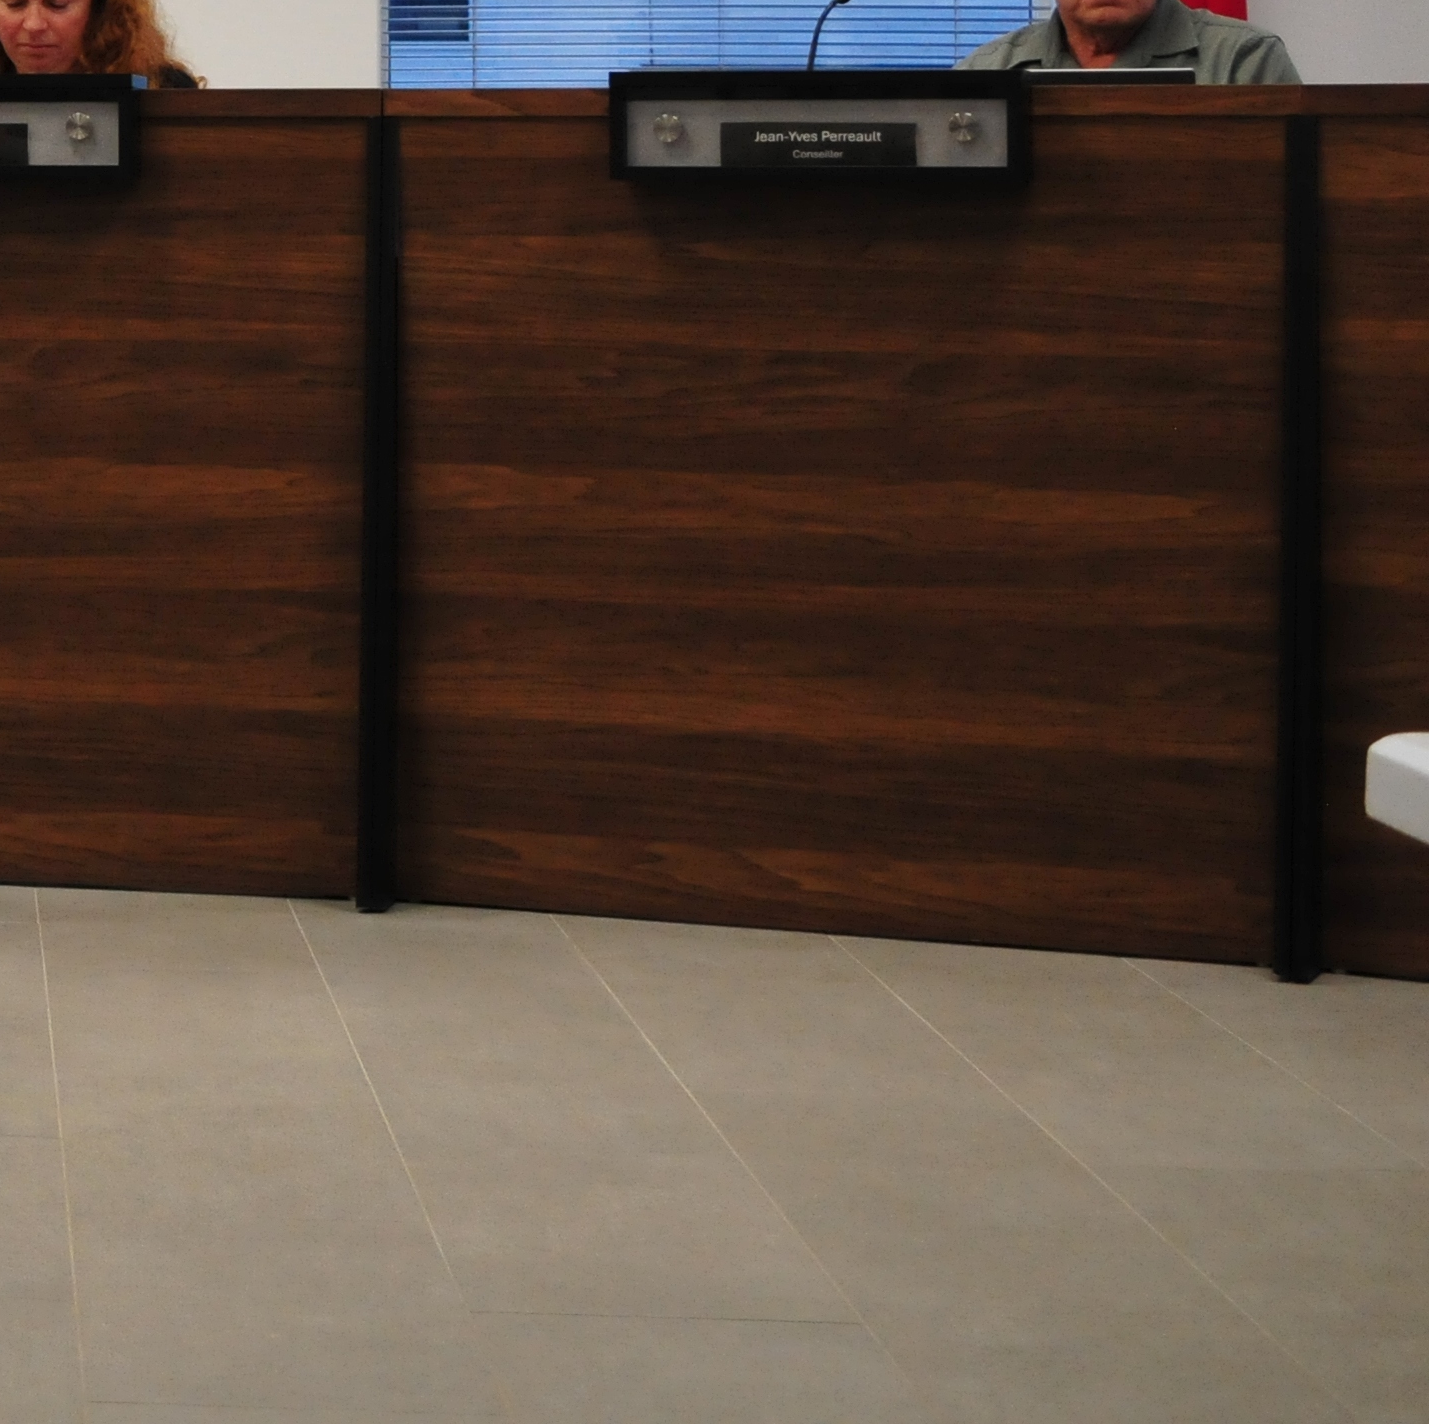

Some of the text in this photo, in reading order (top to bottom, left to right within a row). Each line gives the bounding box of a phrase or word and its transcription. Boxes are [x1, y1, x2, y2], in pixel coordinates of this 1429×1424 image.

[754, 130, 882, 142] Jean-Yves Perreault
[792, 149, 844, 159] Conseiller
